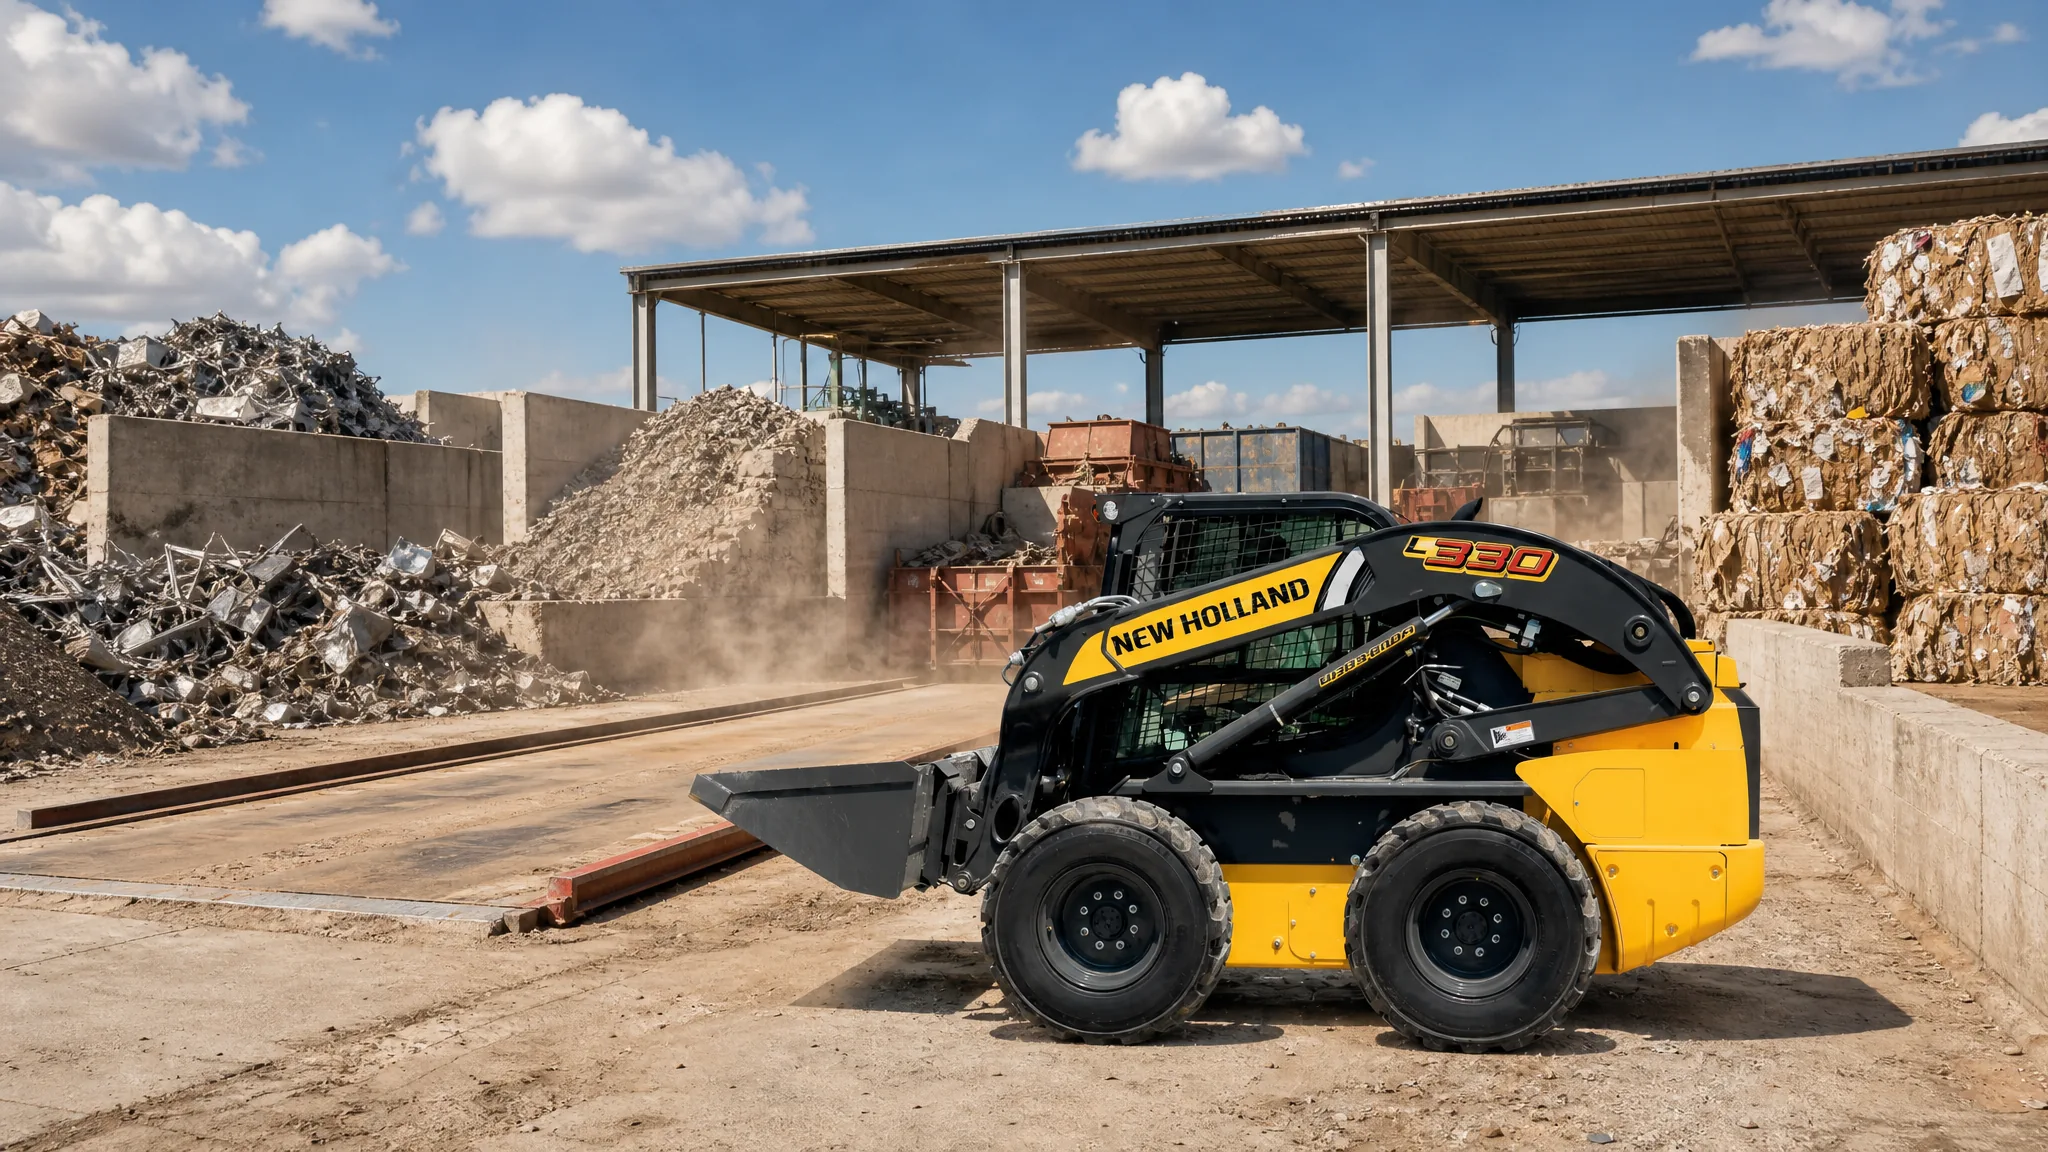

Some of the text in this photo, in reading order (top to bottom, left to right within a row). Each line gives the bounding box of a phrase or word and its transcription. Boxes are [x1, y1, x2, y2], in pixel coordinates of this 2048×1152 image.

[1404, 537, 1557, 578] L330
[1111, 578, 1310, 656] NEW HOLLAND
